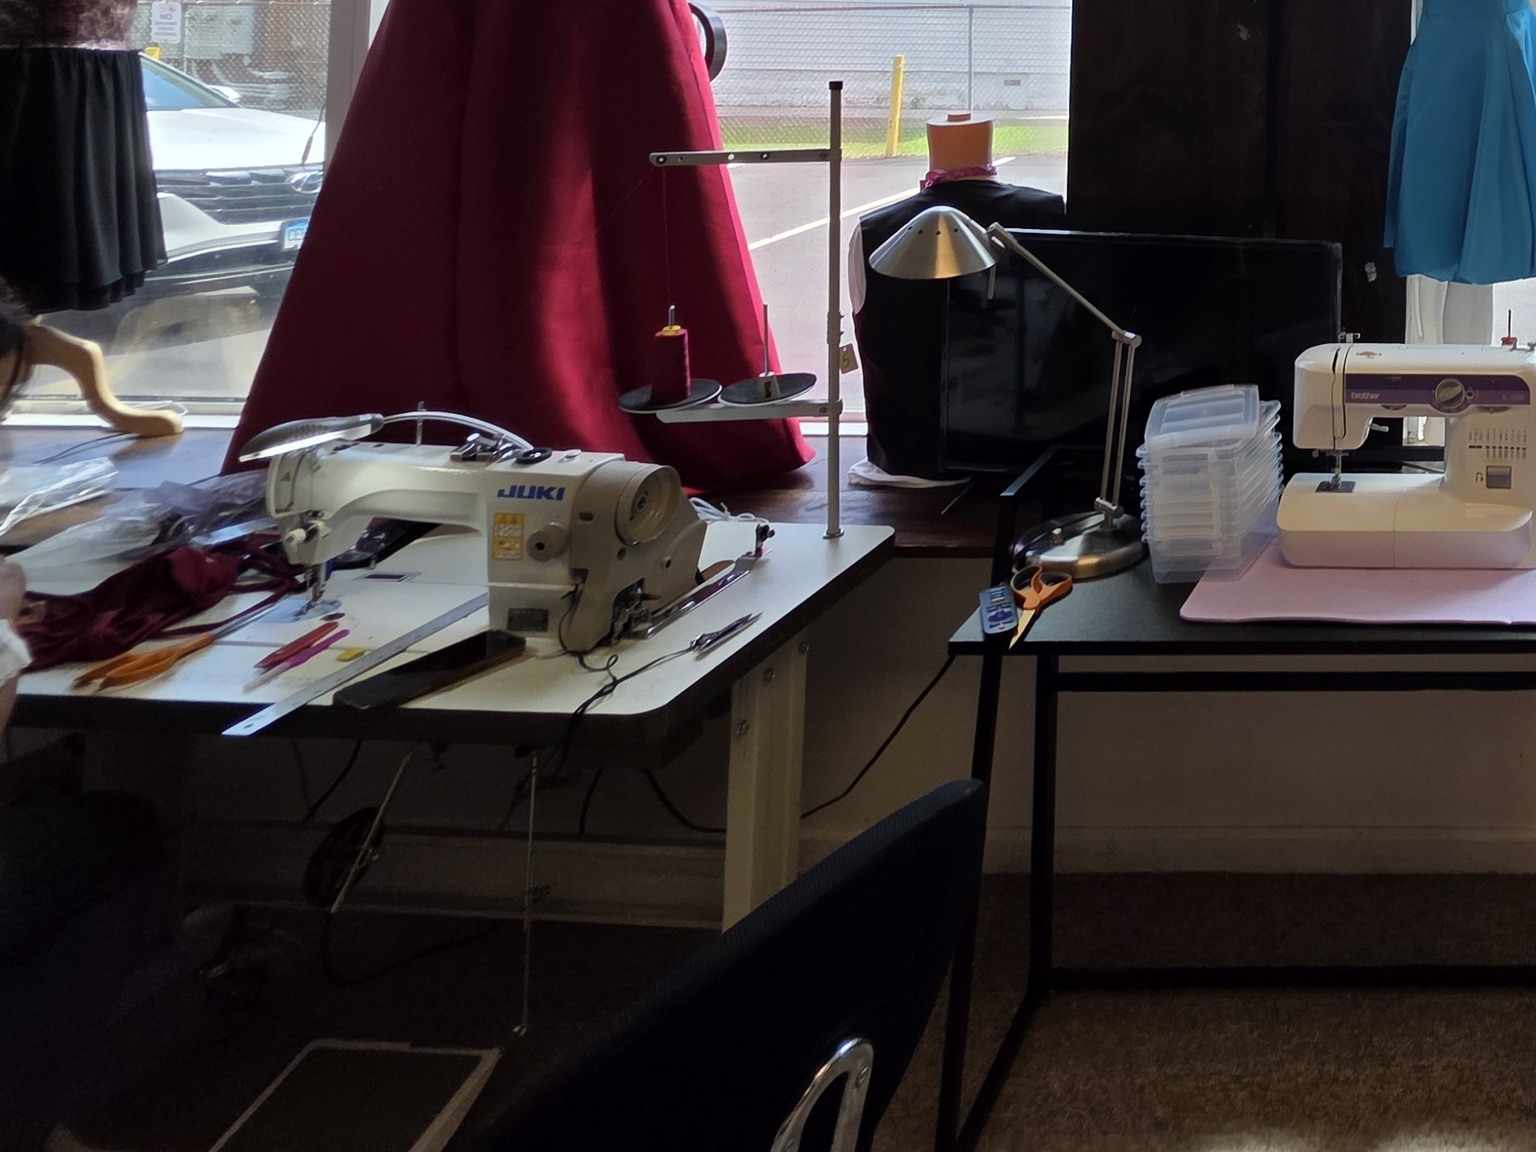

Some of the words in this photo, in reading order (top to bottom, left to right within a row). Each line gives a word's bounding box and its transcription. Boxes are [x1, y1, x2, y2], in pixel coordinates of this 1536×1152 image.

[159, 13, 173, 21] NO
[1350, 391, 1380, 400] brother
[497, 485, 566, 502] JUKI
